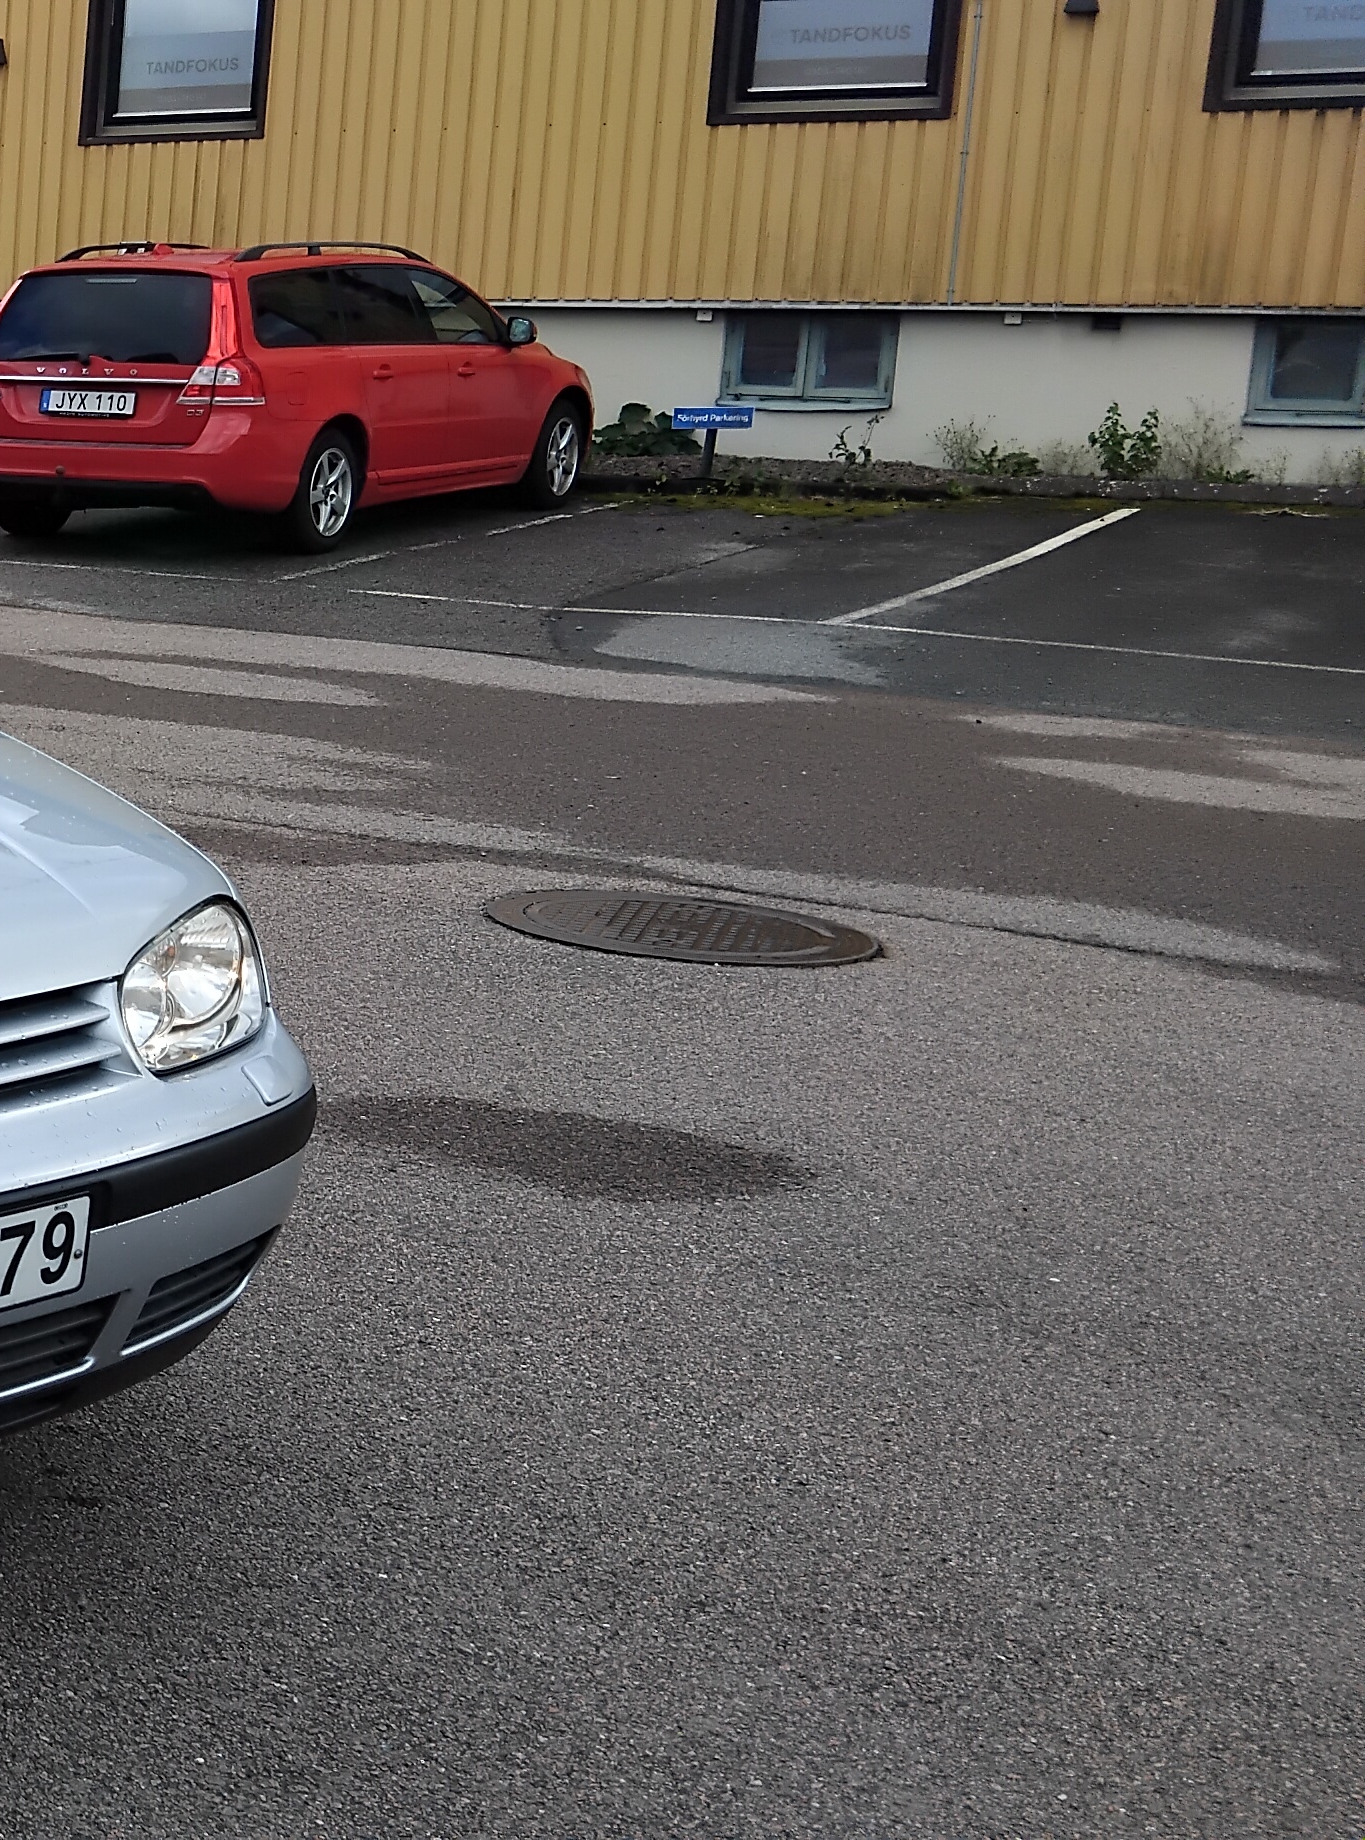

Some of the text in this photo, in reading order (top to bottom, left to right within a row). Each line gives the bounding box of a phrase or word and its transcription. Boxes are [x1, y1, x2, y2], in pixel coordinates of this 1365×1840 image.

[790, 25, 911, 44] TANDFOKUS
[147, 57, 239, 75] TANDFOKUS
[36, 367, 138, 376] VOLVO
[55, 392, 127, 412] JYX 110
[710, 414, 749, 422] Parkering
